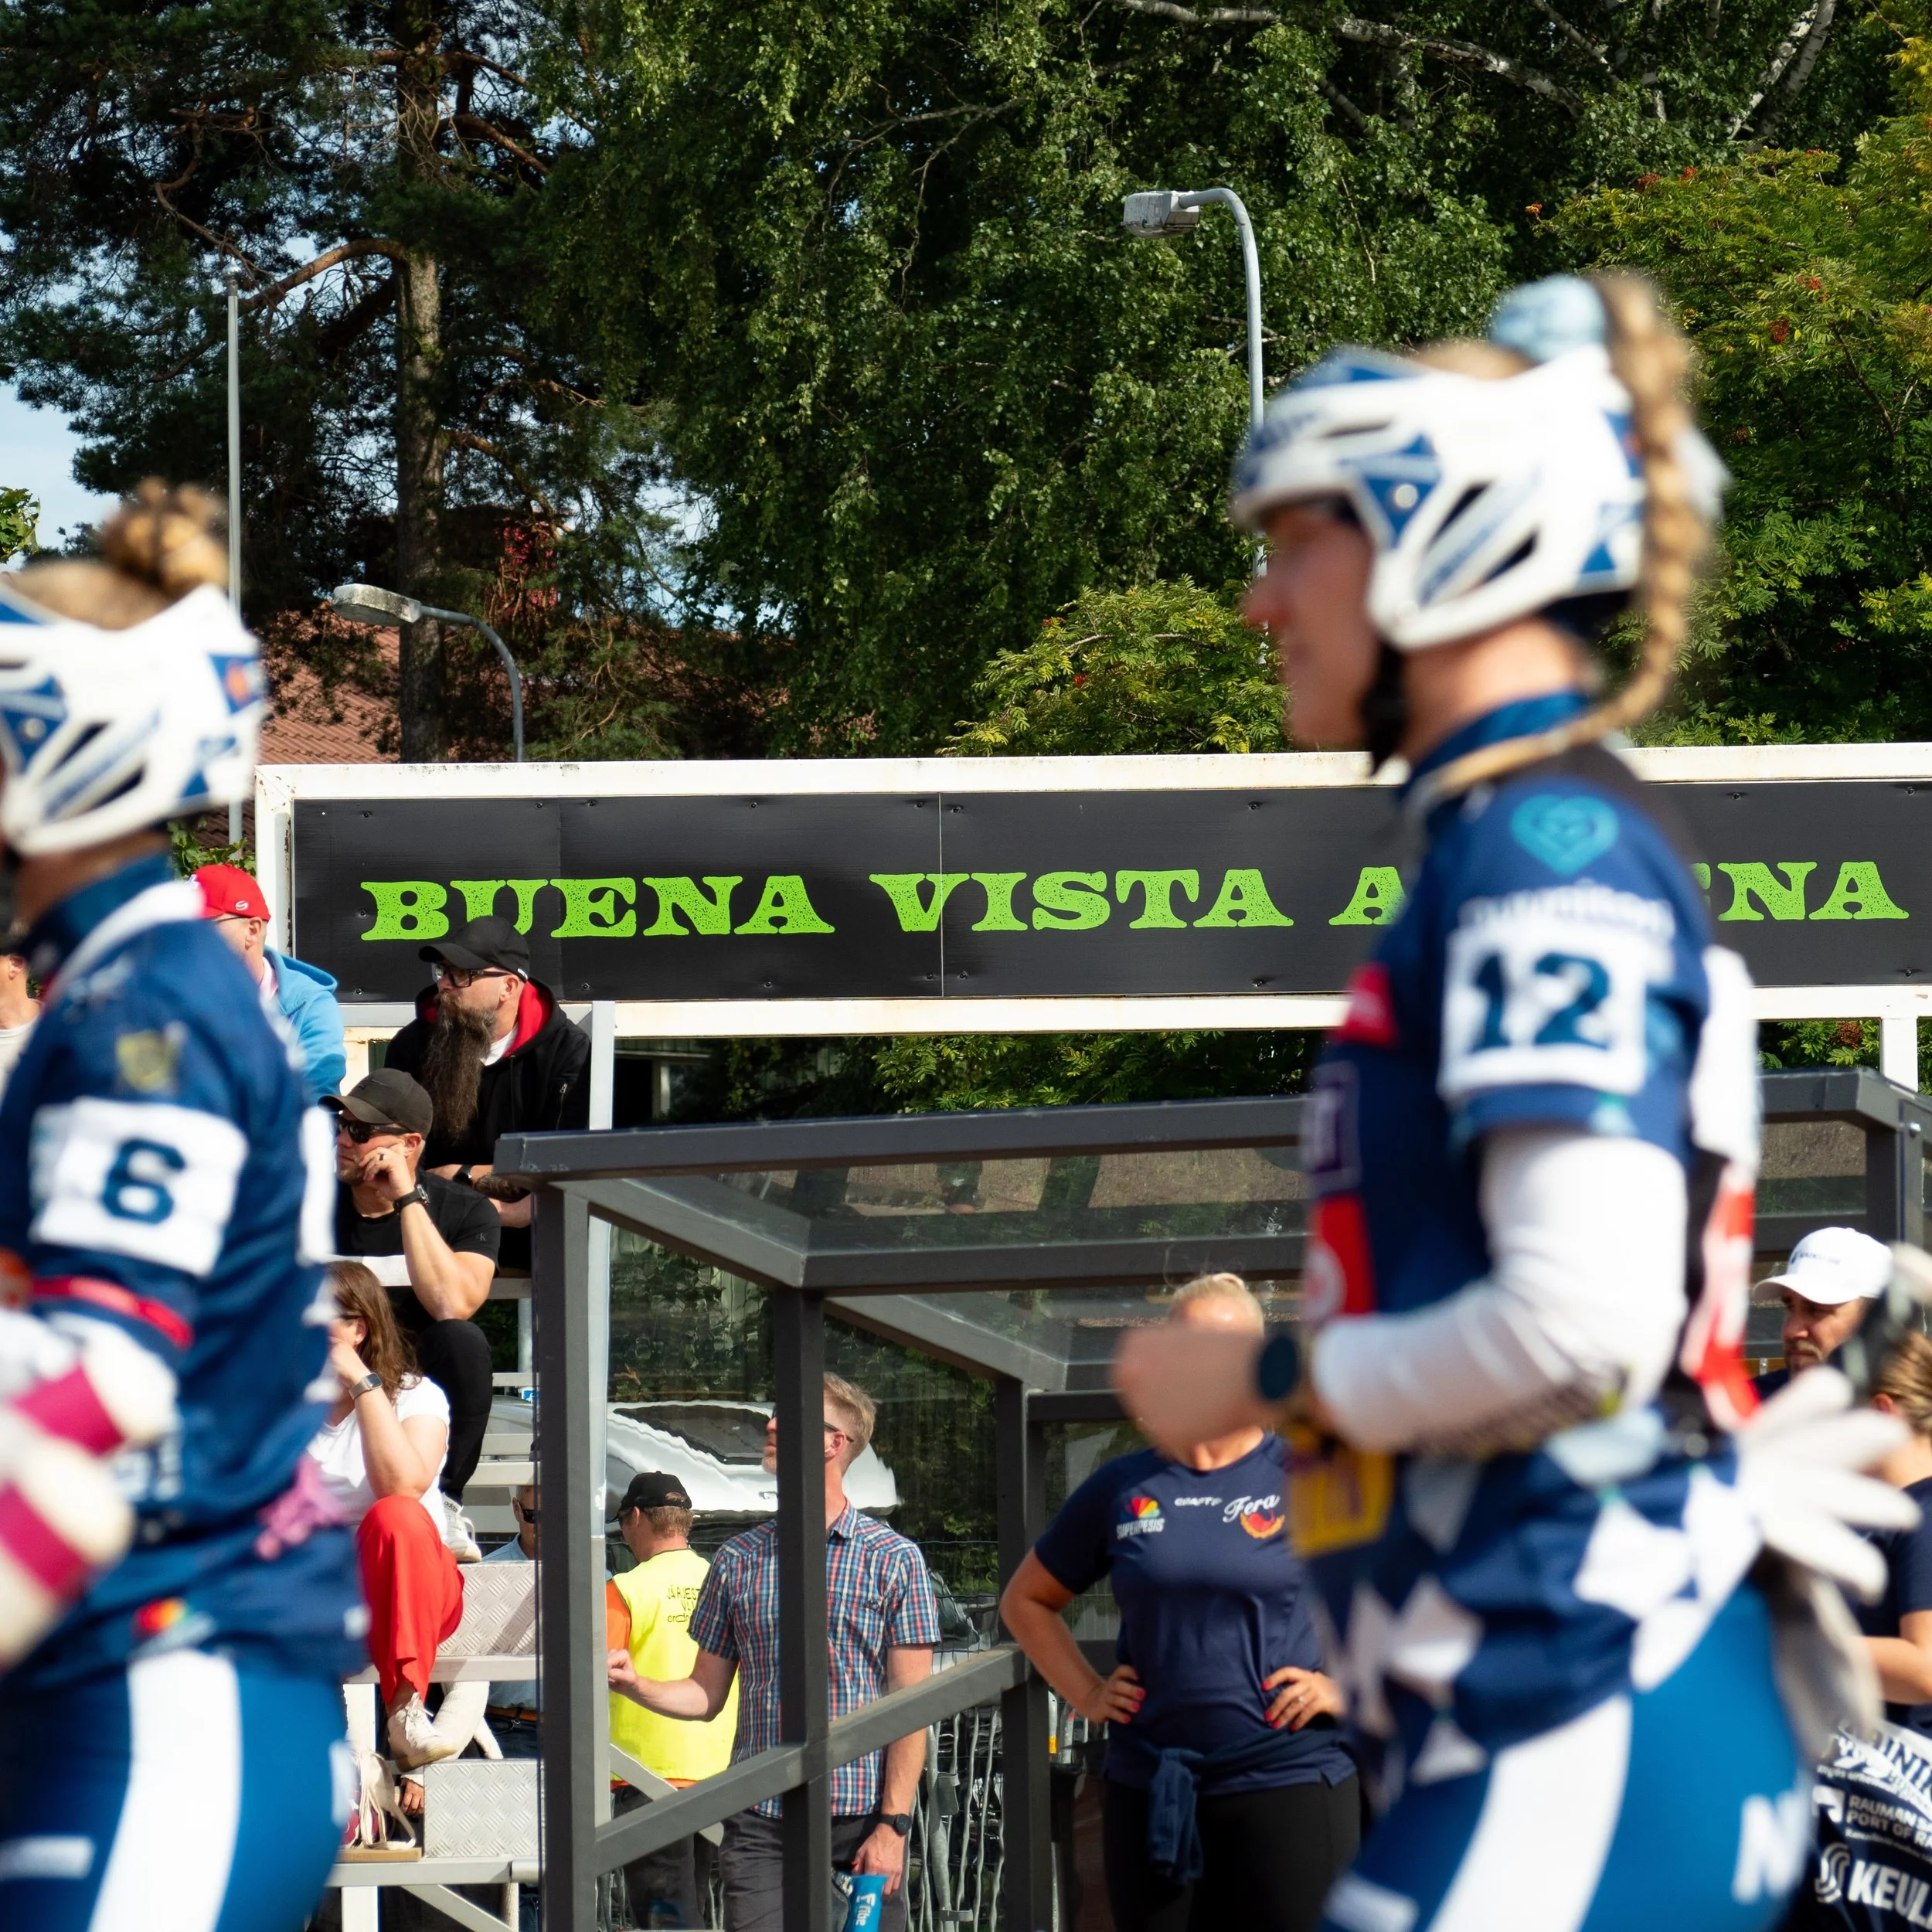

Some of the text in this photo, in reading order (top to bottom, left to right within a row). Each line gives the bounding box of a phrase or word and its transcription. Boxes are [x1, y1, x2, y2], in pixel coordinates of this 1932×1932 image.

[360, 875, 835, 940] BUENA
[869, 869, 1294, 932] VISTA
[1467, 951, 1612, 1055] 12
[101, 1136, 187, 1226] 6
[1116, 1518, 1165, 1540] SUPERPESIS
[1223, 1495, 1280, 1523] Fera
[1845, 1809, 1889, 1831] PORT
[1892, 1823, 1913, 1839] OF
